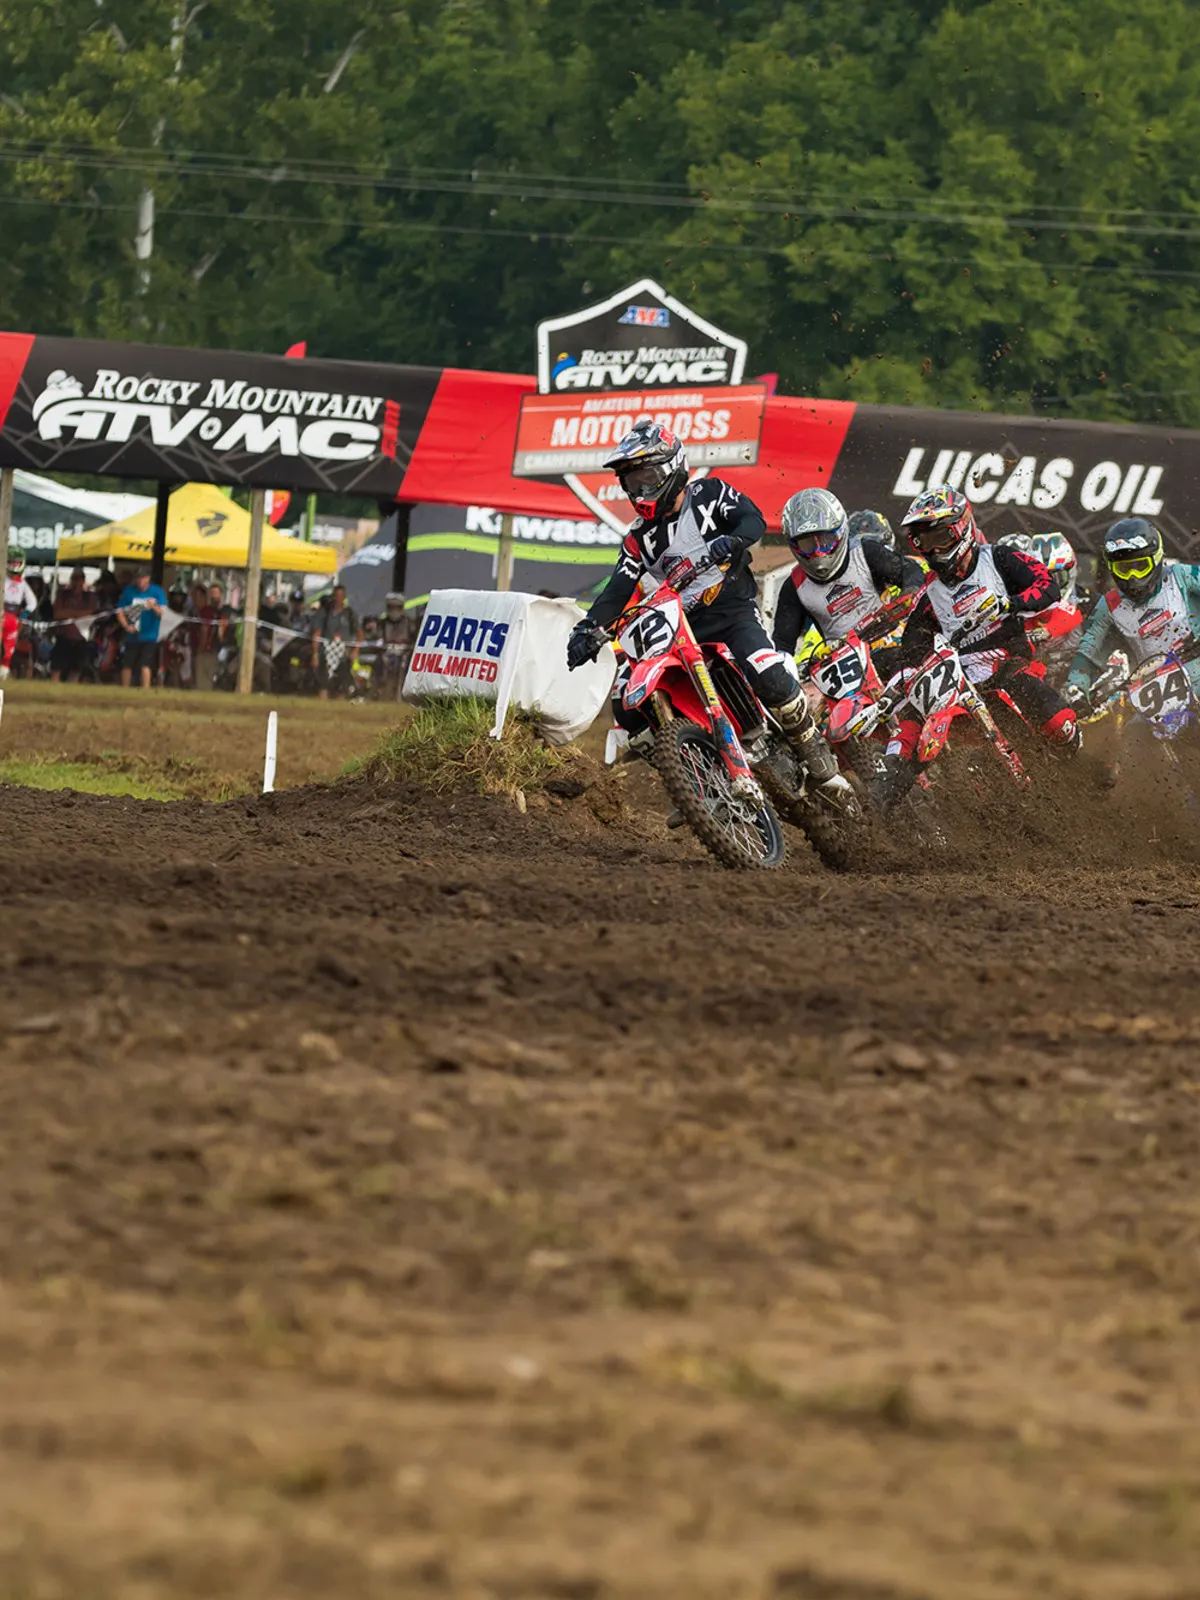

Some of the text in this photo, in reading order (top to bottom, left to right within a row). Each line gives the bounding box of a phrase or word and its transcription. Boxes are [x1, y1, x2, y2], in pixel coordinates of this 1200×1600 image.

[617, 305, 671, 328] AMA
[579, 346, 728, 366] ROCKY MOUNTAIN
[88, 369, 384, 421] ROCKY MOUNTAIN
[892, 447, 1165, 516] LUCAS OIL
[417, 614, 510, 658] PARTS
[411, 652, 498, 683] UNLIMITED
[822, 657, 864, 697] 35
[915, 659, 957, 714] 22
[1139, 670, 1187, 719] 94
